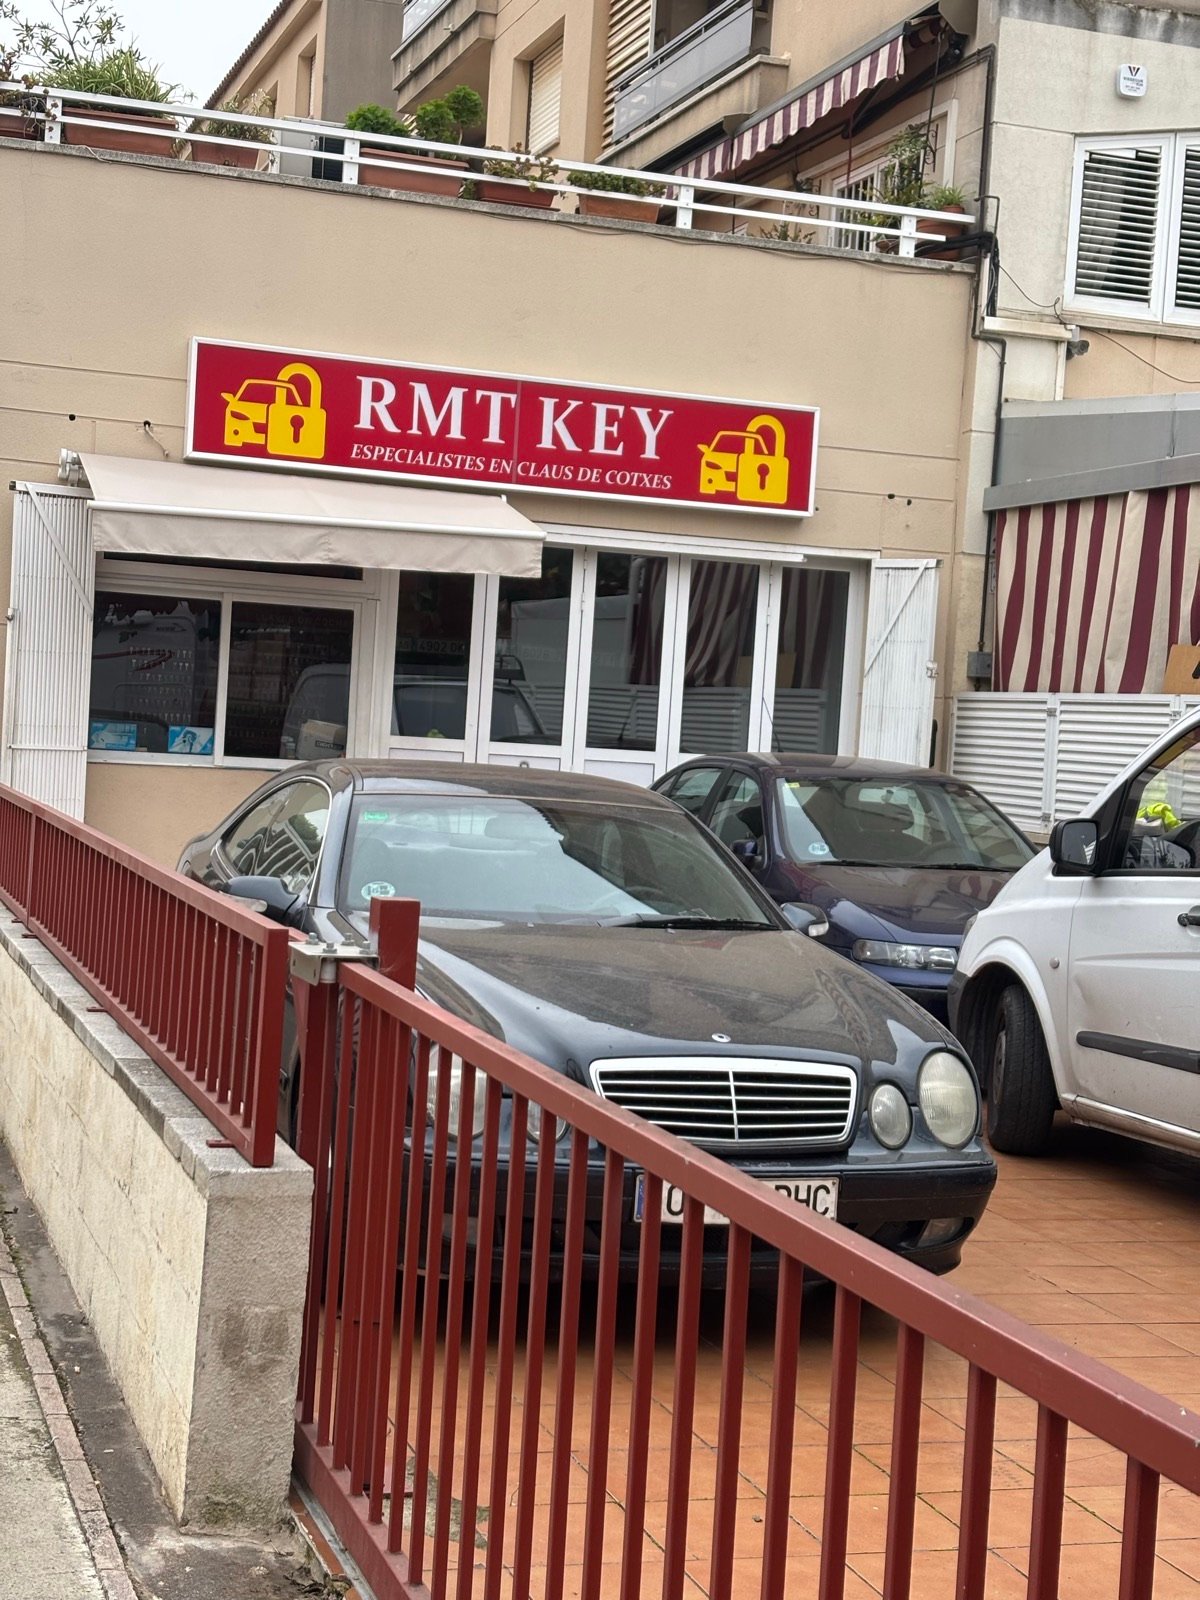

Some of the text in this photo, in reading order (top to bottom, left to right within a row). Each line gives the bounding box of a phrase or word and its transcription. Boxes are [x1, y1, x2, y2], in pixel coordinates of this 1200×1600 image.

[353, 375, 674, 461] RMT KEY
[350, 443, 672, 490] ESPECIALISTES EN CLAUS DE COTXES
